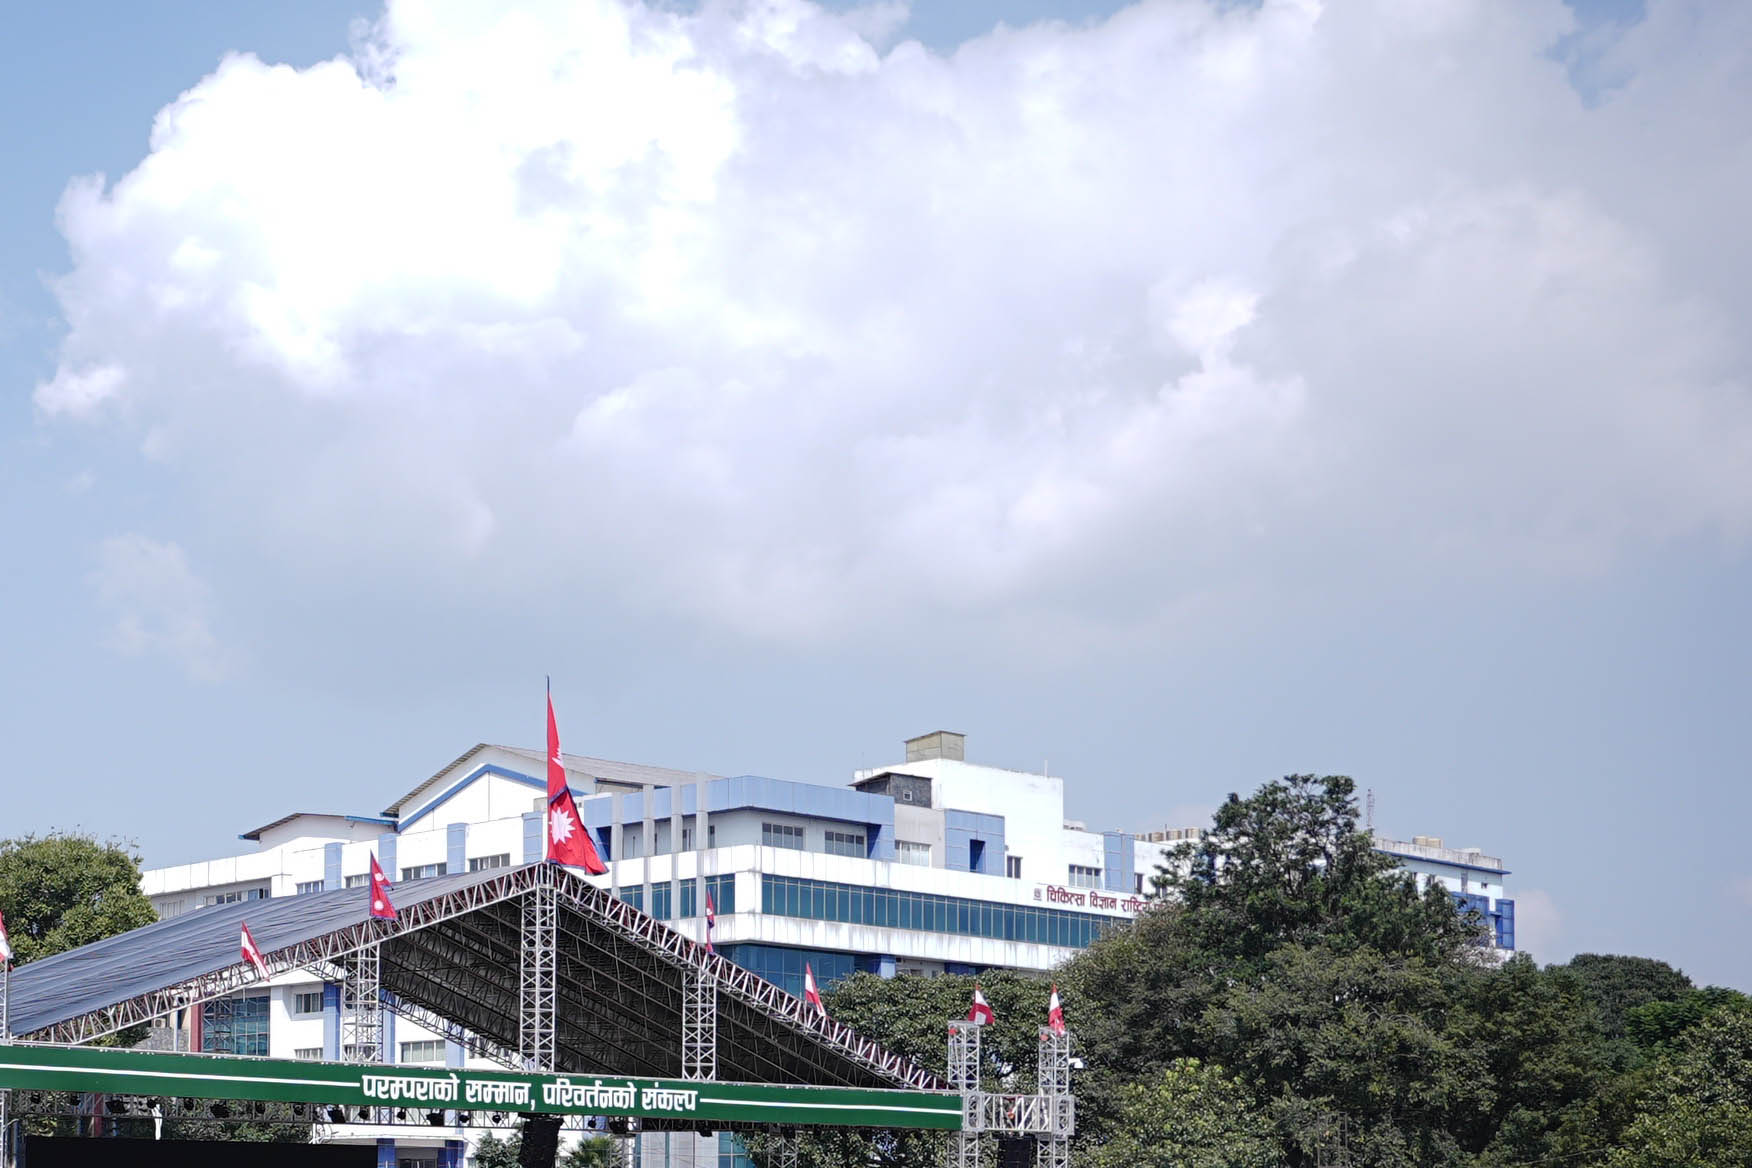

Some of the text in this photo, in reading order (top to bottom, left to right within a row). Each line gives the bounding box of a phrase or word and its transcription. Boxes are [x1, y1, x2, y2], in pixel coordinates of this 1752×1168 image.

[361, 1073, 698, 1111] परम्पराको सम्मान, परिवर्तनको संकल्प
